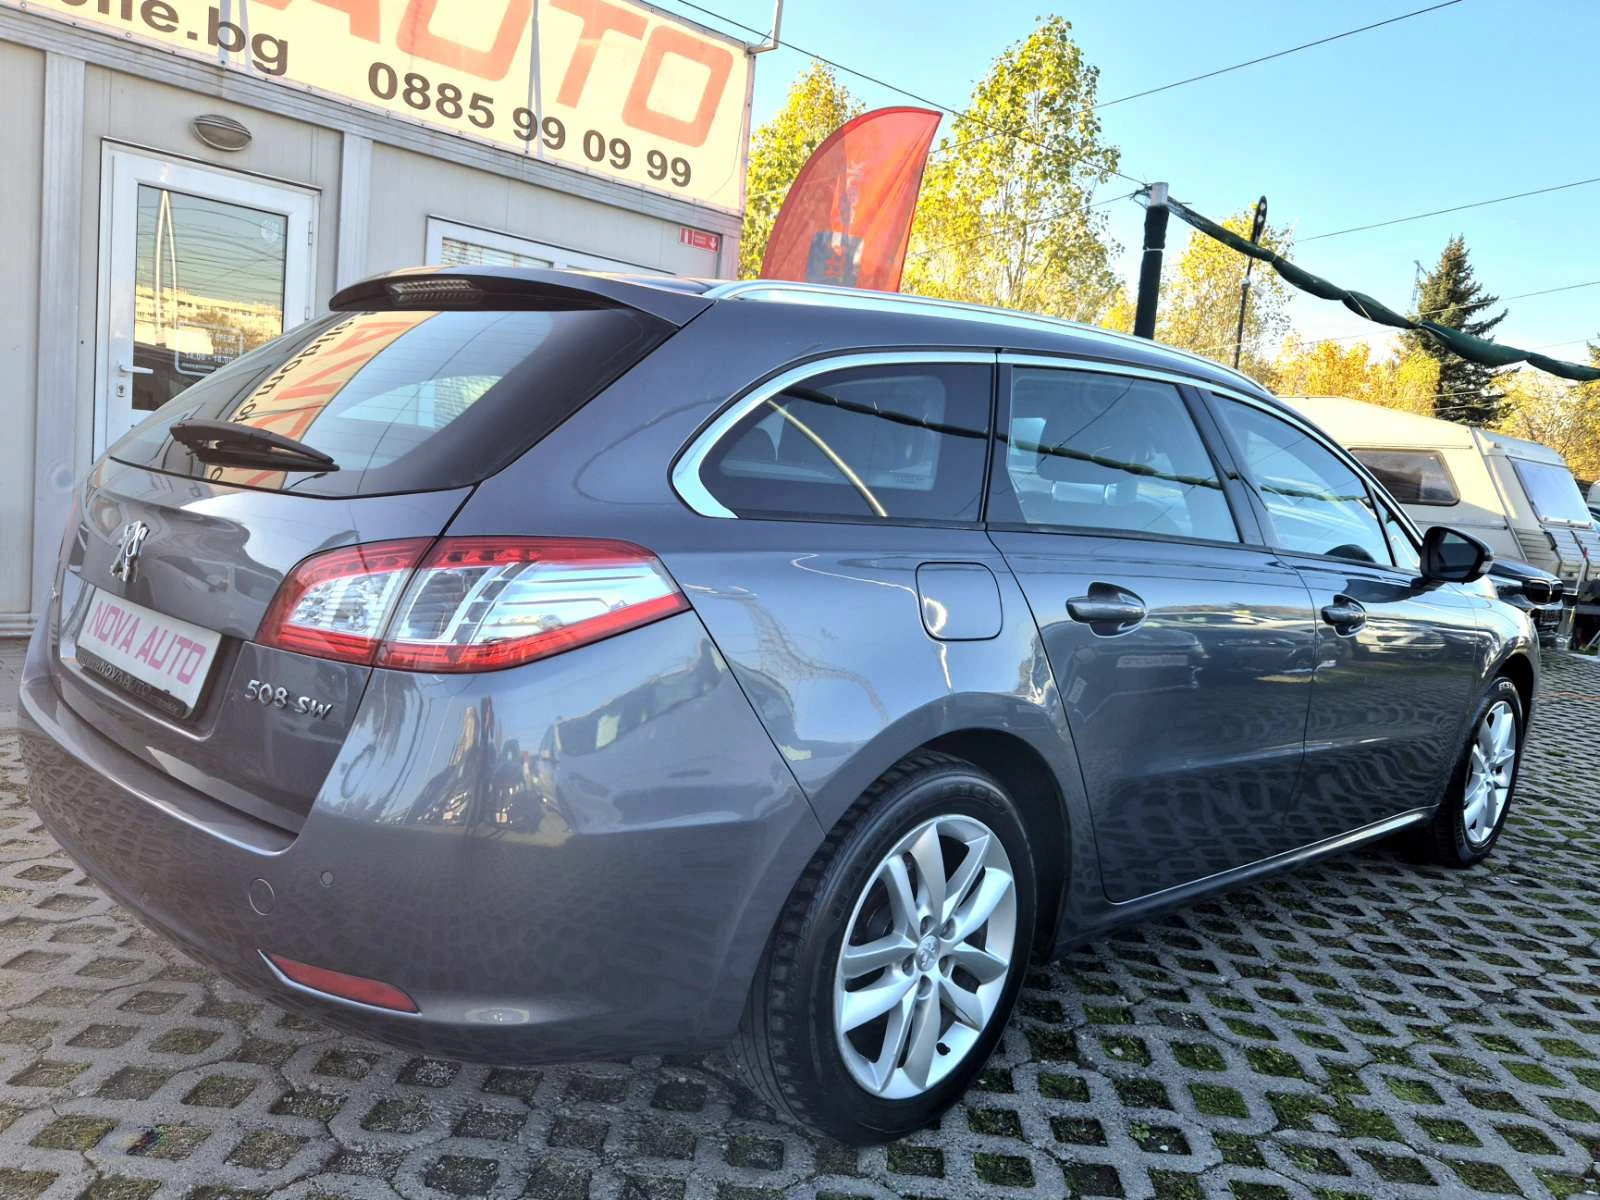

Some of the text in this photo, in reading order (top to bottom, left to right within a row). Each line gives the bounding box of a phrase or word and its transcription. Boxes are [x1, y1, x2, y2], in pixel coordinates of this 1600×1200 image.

[368, 62, 692, 187] 0885 99 09 99
[87, 600, 208, 685] NOVA AUTO
[244, 679, 333, 720] 508 SW
